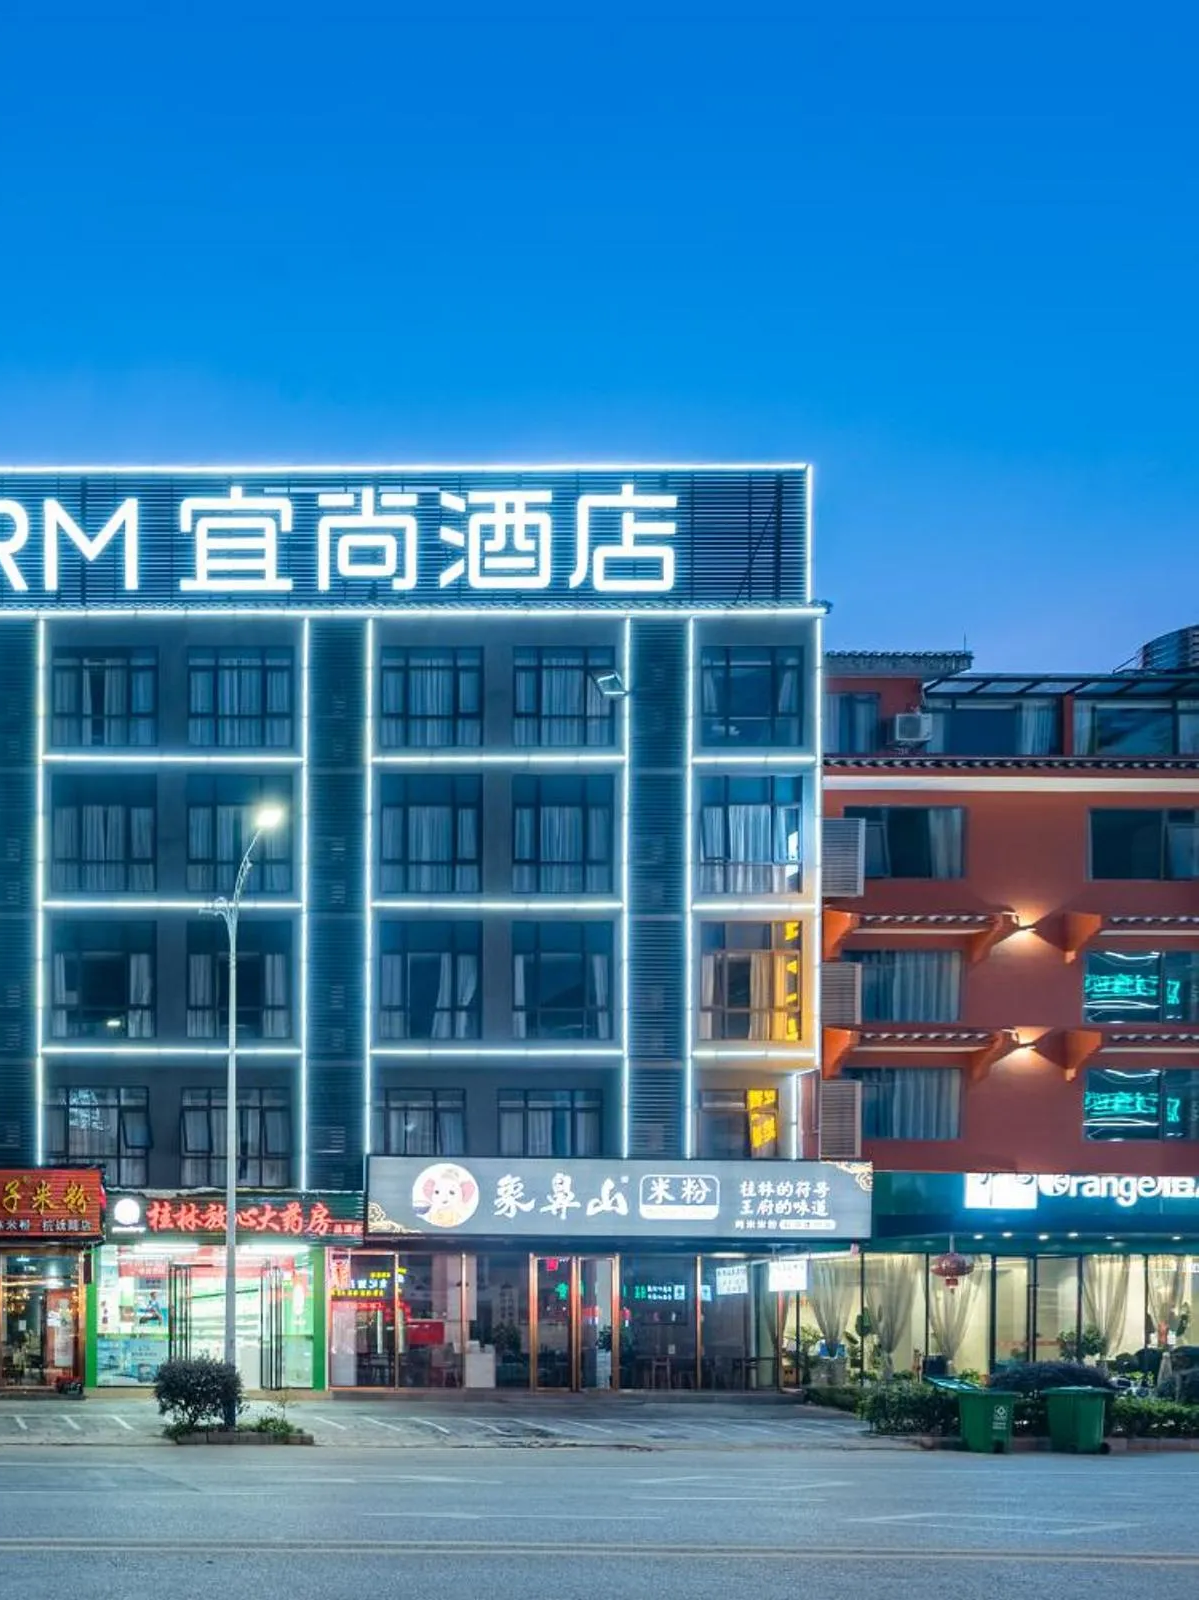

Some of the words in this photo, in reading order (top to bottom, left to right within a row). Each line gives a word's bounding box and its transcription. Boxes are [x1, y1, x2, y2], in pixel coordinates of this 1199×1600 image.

[180, 485, 678, 592] 宜尚酒店
[494, 1173, 629, 1220] 象鼻山
[647, 1176, 712, 1204] 米粉
[739, 1180, 831, 1199] 桂林的符号
[146, 1201, 333, 1235] 桂林放心大药房
